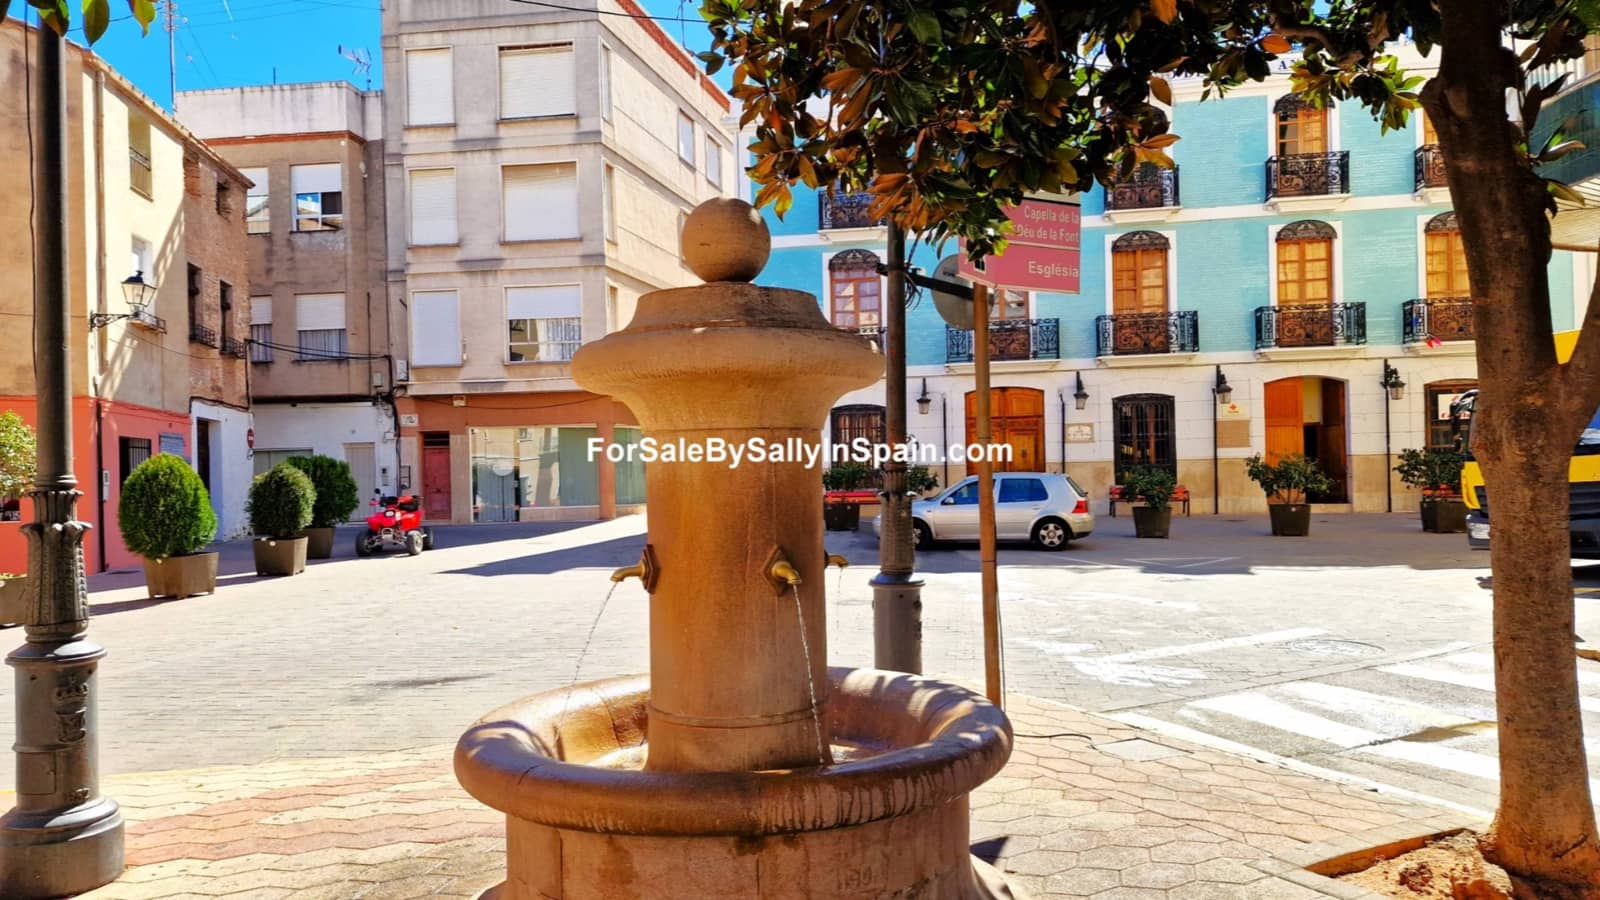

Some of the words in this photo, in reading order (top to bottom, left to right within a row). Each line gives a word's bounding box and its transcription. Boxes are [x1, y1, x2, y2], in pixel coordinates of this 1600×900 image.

[1024, 205, 1057, 222] Capella
[1059, 210, 1070, 223] de
[1071, 211, 1080, 224] la
[1037, 226, 1048, 239] de
[1049, 228, 1058, 240] la
[1059, 228, 1079, 242] Font
[1028, 260, 1079, 278] Església
